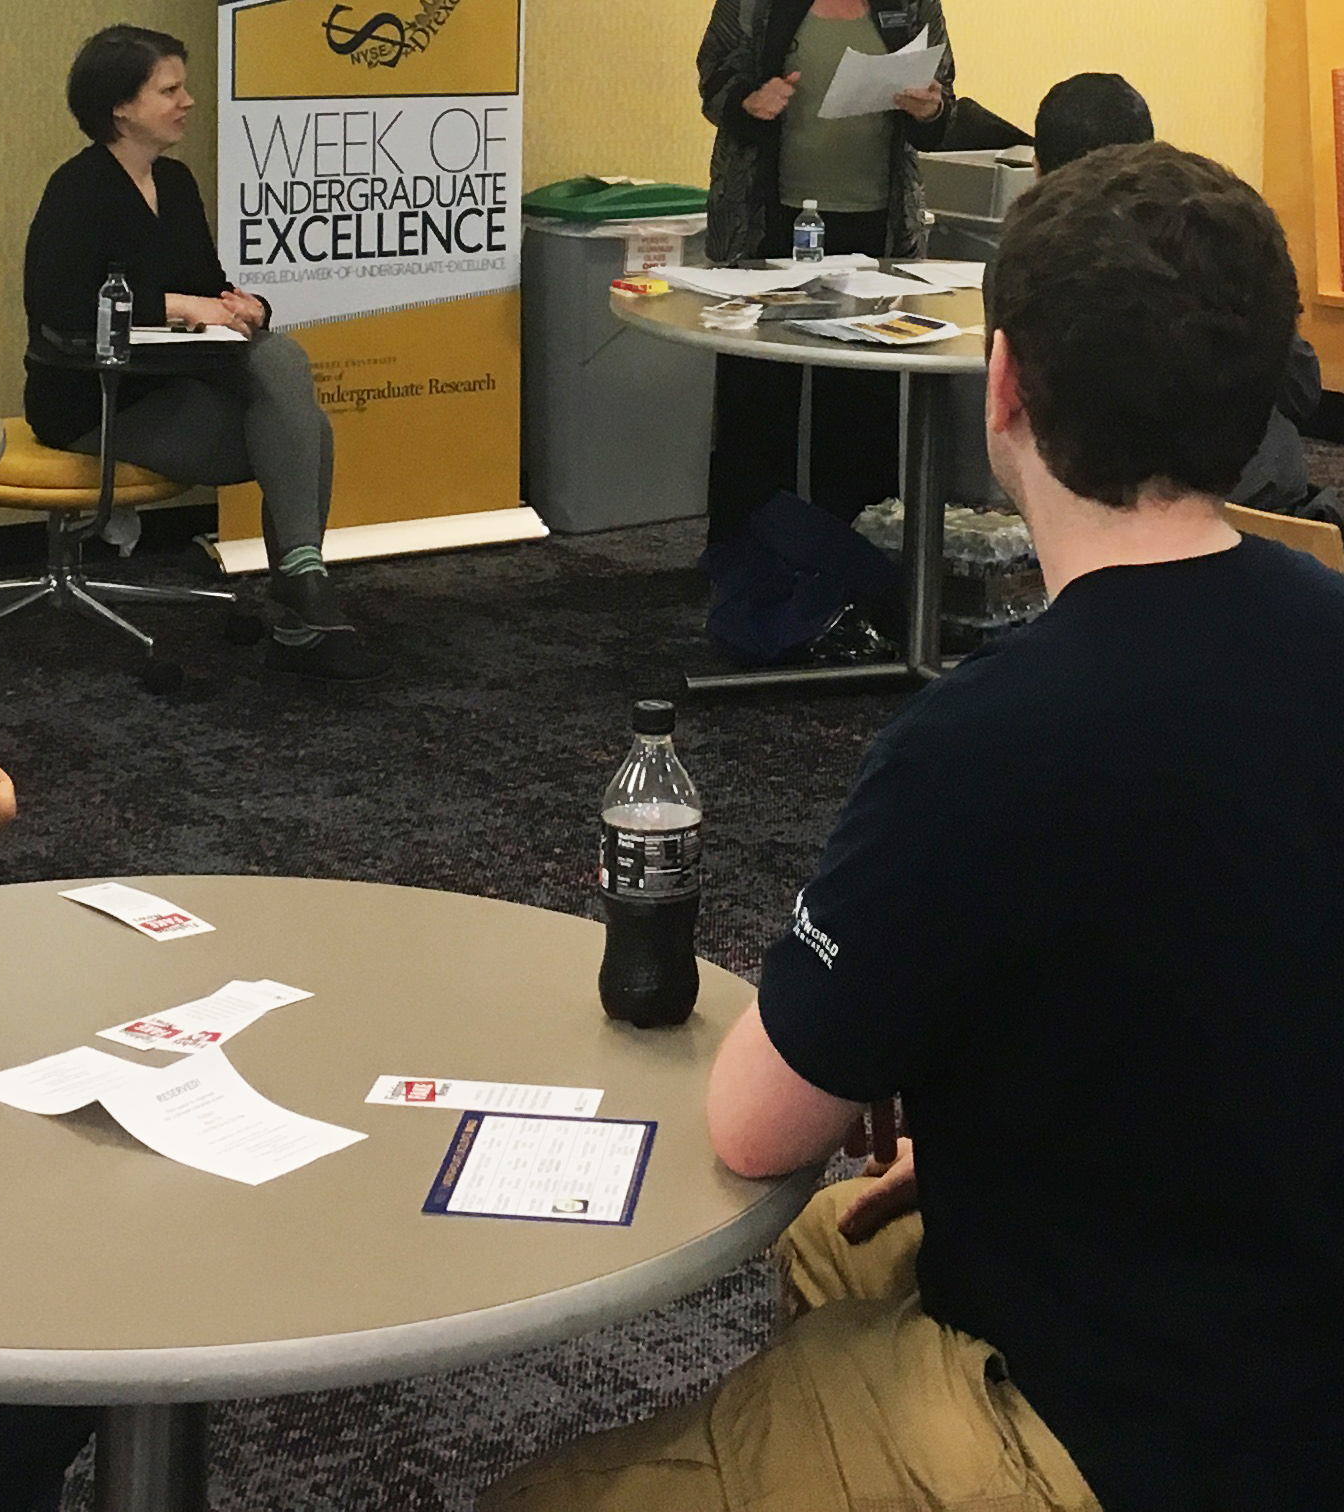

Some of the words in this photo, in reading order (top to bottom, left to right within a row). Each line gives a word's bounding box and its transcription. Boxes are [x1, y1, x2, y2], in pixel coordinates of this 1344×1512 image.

[350, 43, 392, 66] NYSE
[241, 110, 406, 180] WEEK
[429, 107, 508, 174] OF
[239, 171, 507, 218] UNDERGRADUATE
[239, 206, 507, 266] EXCELLENCE
[313, 371, 333, 383] ffice
[333, 370, 345, 381] of
[428, 372, 497, 396] Research
[155, 1077, 202, 1104] RESERVED!
